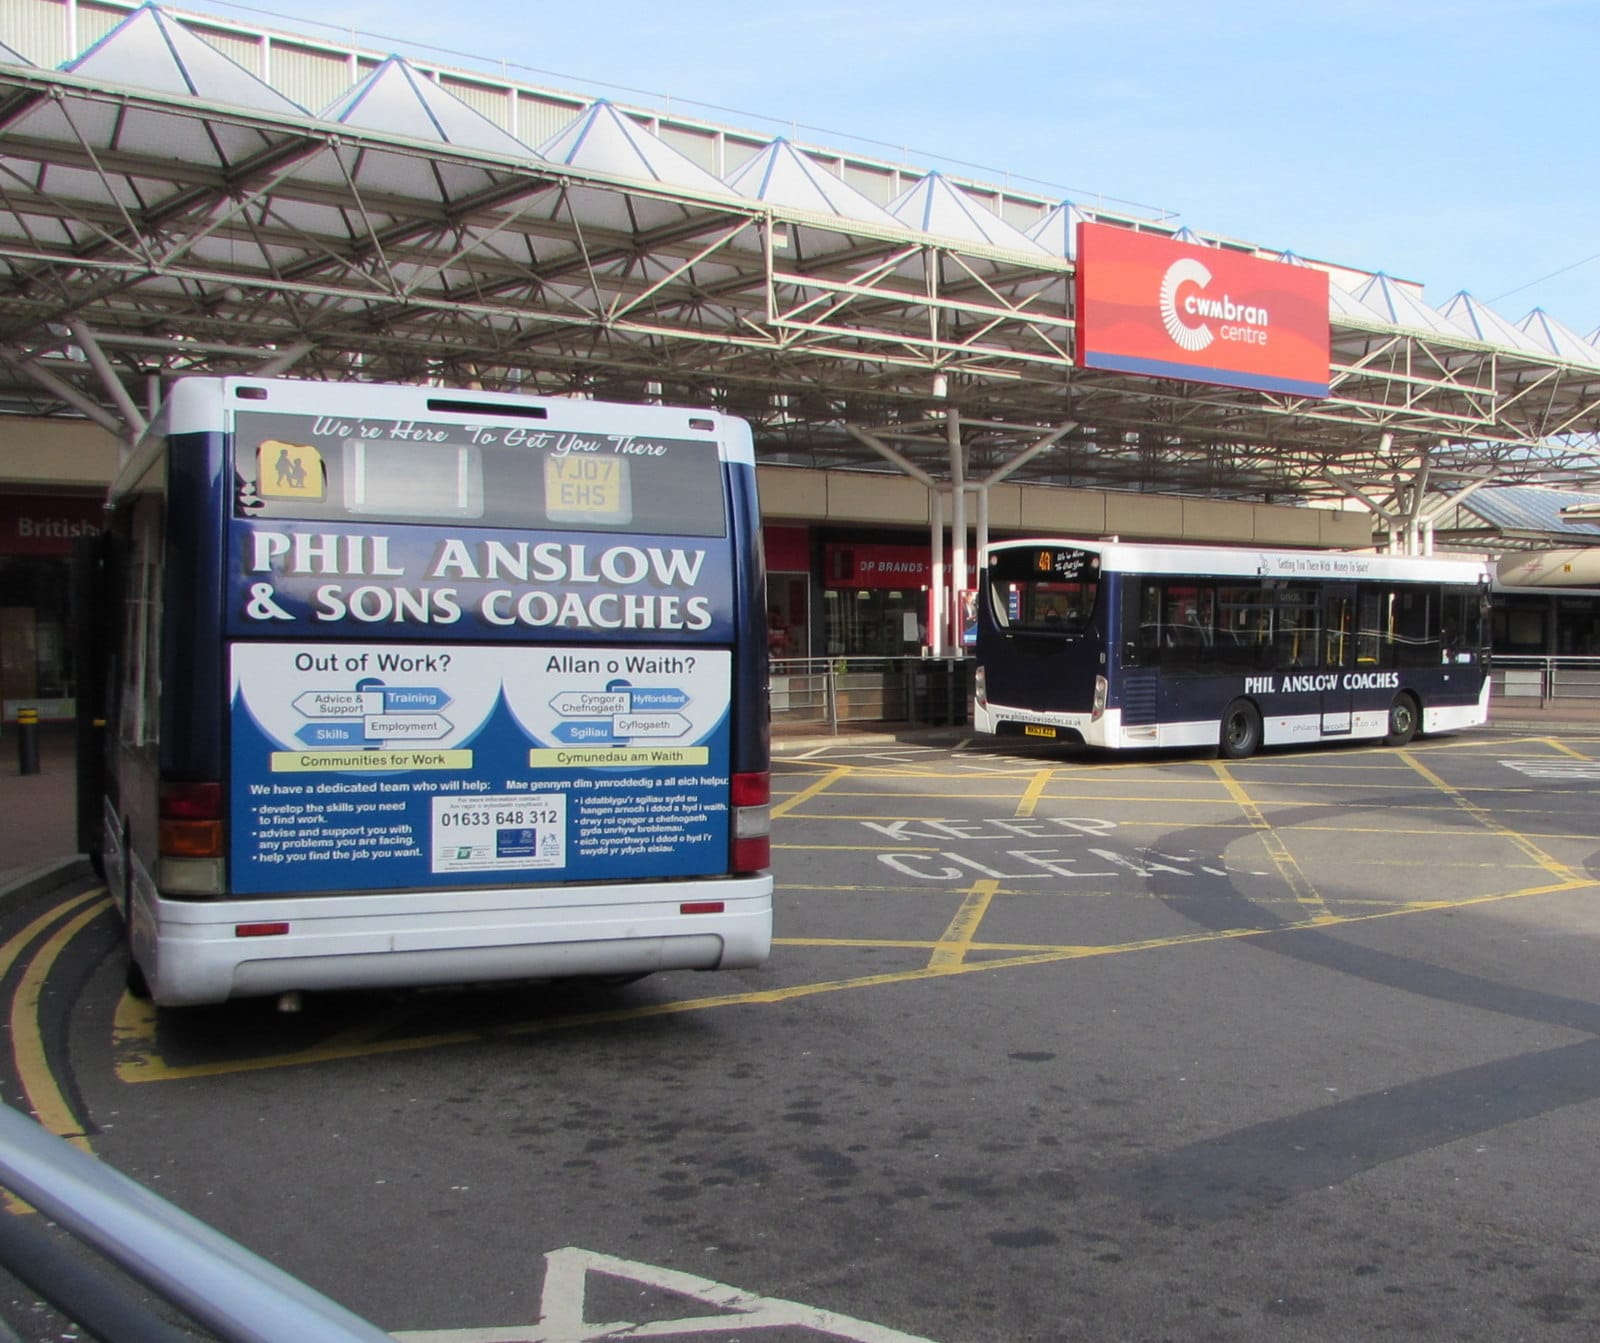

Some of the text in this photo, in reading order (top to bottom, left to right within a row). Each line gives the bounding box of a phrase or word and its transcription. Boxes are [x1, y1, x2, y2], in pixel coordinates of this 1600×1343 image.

[1185, 295, 1268, 326] cwmbran
[1221, 325, 1267, 345] centre
[313, 416, 668, 457] We're Here To Get You There
[553, 458, 613, 480] YJ07
[561, 483, 606, 505] EHS
[252, 531, 706, 586] PHIL ANSLOW
[878, 561, 923, 573] BRANDS
[246, 582, 713, 631] & SONS COACHES
[295, 653, 452, 672] Out of Work?
[546, 656, 696, 674] Allan o Waith?
[1245, 672, 1399, 694] PHIL ANSLOW COACHES
[315, 694, 364, 704] Advice &
[388, 692, 437, 705] Training
[580, 695, 616, 705] Cyngor
[319, 704, 364, 715] Support
[562, 703, 624, 714] Chefnogaeth
[371, 721, 438, 732] Employment
[619, 720, 670, 730] Cyflogaeth
[316, 729, 349, 739] Skills
[570, 727, 608, 738] Sgiliau
[300, 754, 445, 767] Communities for Work
[557, 751, 683, 764] Cymunedau am Waith
[250, 785, 271, 794] We
[273, 784, 303, 794] have
[316, 783, 377, 793] dedicated
[380, 783, 409, 792] team
[413, 782, 437, 791] who
[439, 780, 460, 790] will
[462, 780, 491, 792] help:
[506, 780, 528, 790] Mae
[530, 780, 571, 791] gennym
[595, 778, 654, 790] ymroddedig
[664, 777, 676, 786] all
[678, 777, 698, 786] eich
[700, 776, 729, 787] helpu:
[259, 802, 406, 815] develop the skills you need
[580, 806, 613, 815] hangen
[614, 805, 644, 813] arnoch
[651, 804, 672, 812] ddod
[682, 804, 697, 813] hyd
[259, 815, 328, 825] to find work.
[441, 810, 558, 826] 01633 648 312
[259, 825, 412, 838] advise and support you with
[860, 817, 1118, 841] KEEP
[259, 835, 416, 851] any problems you are facing.
[687, 834, 701, 843] hyd
[259, 848, 423, 863] help you find the job you want.
